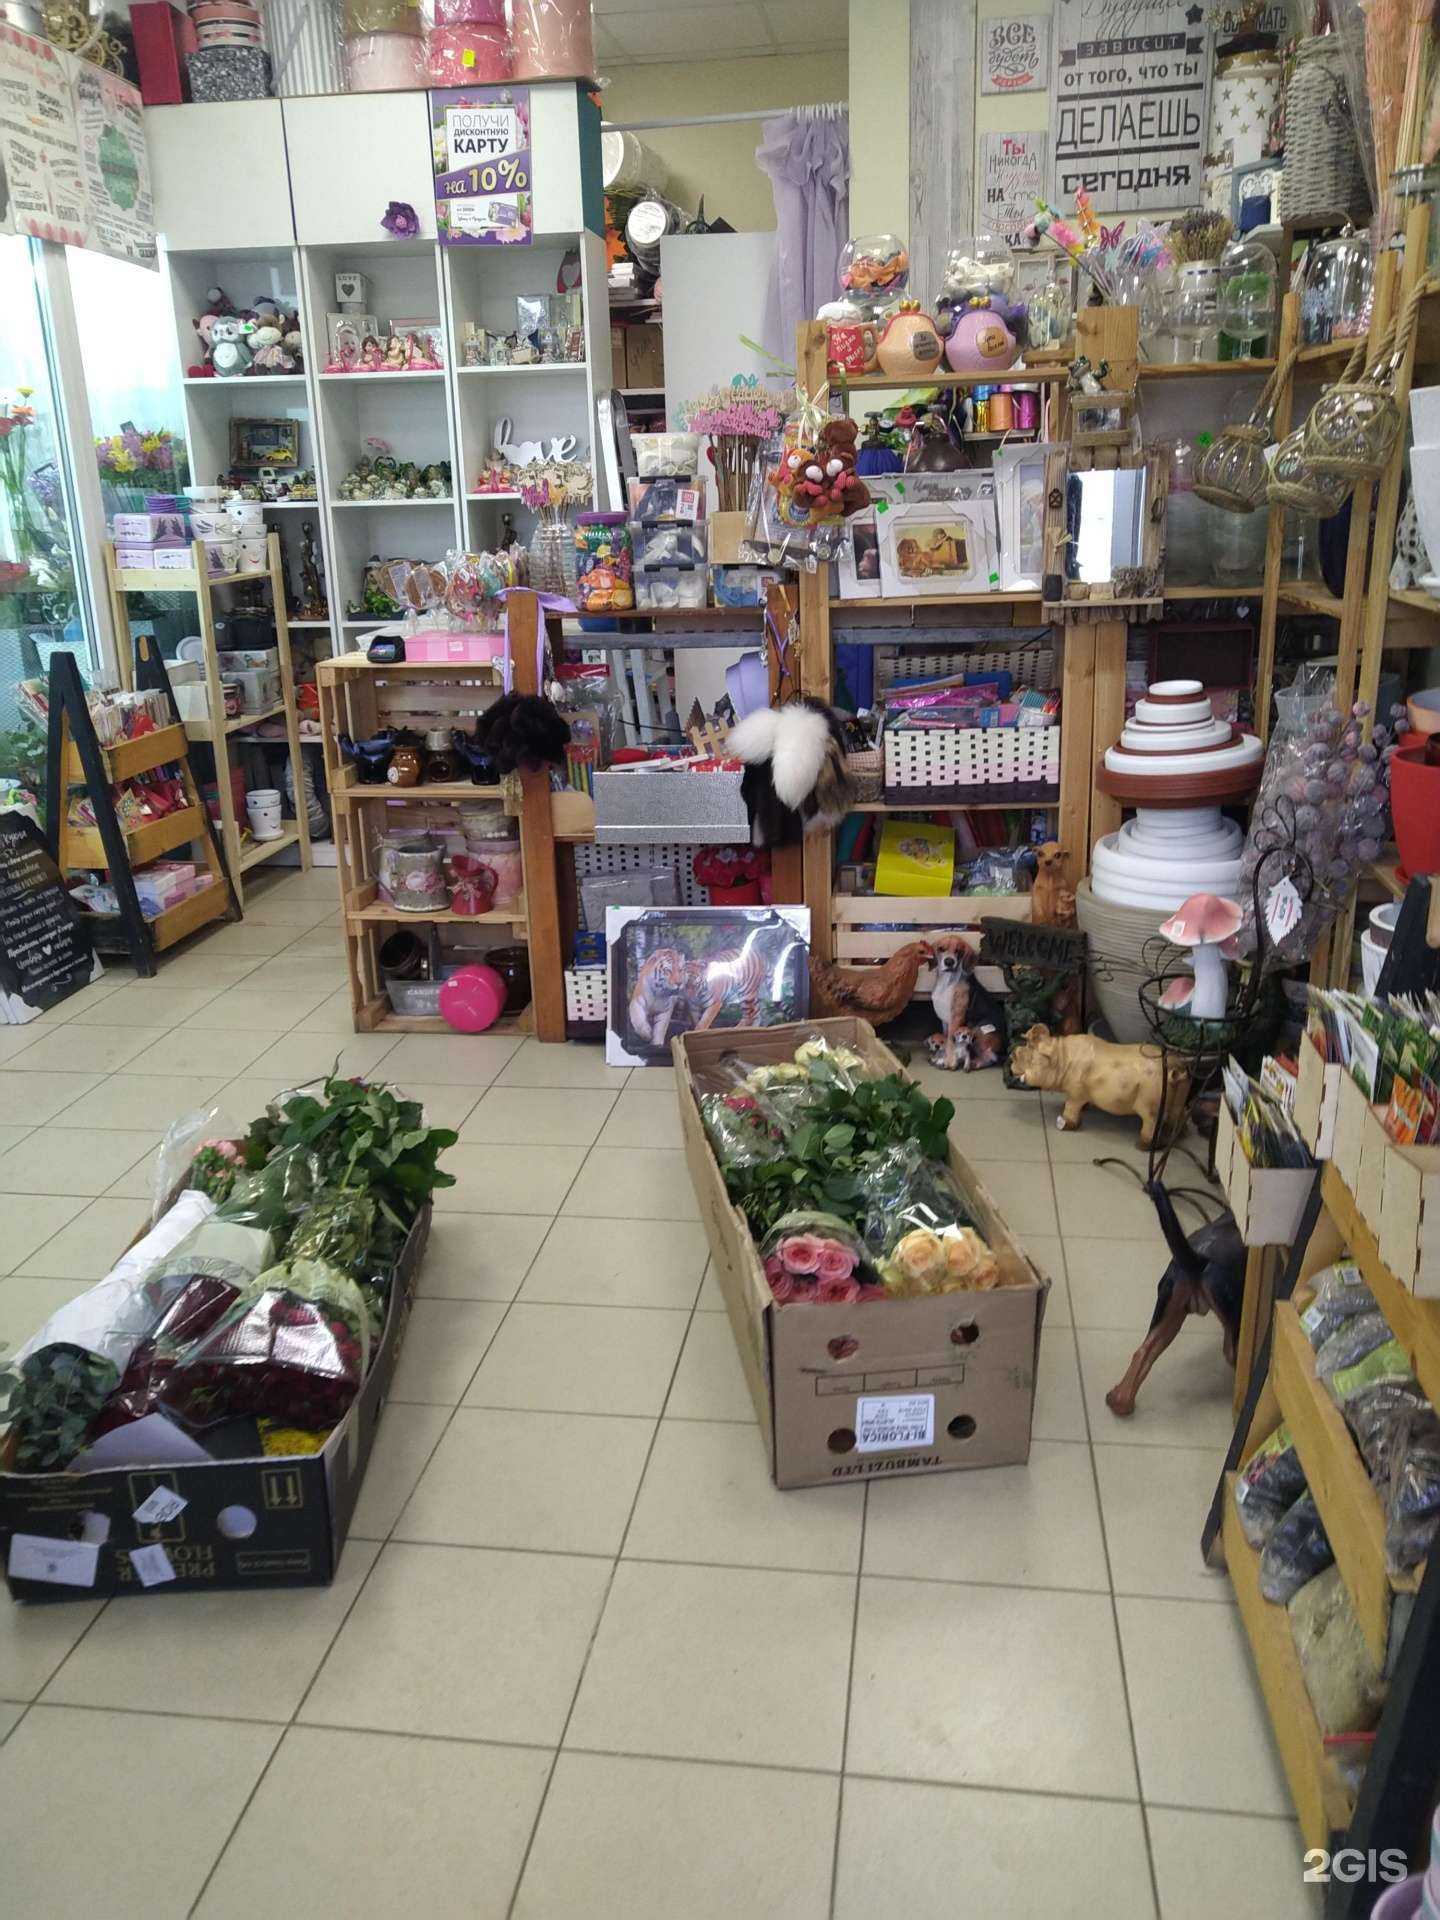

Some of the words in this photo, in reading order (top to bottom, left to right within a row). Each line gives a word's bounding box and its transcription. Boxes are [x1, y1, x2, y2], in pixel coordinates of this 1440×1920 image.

[1086, 36, 1178, 56] зависит
[1139, 65, 1168, 80] ЧТО
[1174, 62, 1198, 76] ТЫ
[452, 114, 510, 128] ПОЛУЧИ
[1056, 98, 1200, 150] ДЕЛАЕШЬ
[453, 128, 509, 138] ДИСКОНТНУЮ
[454, 138, 509, 154] КАРТУ
[444, 179, 468, 195] на
[469, 158, 527, 192] 10%
[1062, 165, 1191, 195] сегодня
[987, 187, 1005, 203] НА
[868, 1455, 943, 1475] TAMBUZI
[119, 1562, 216, 1581] PRER
